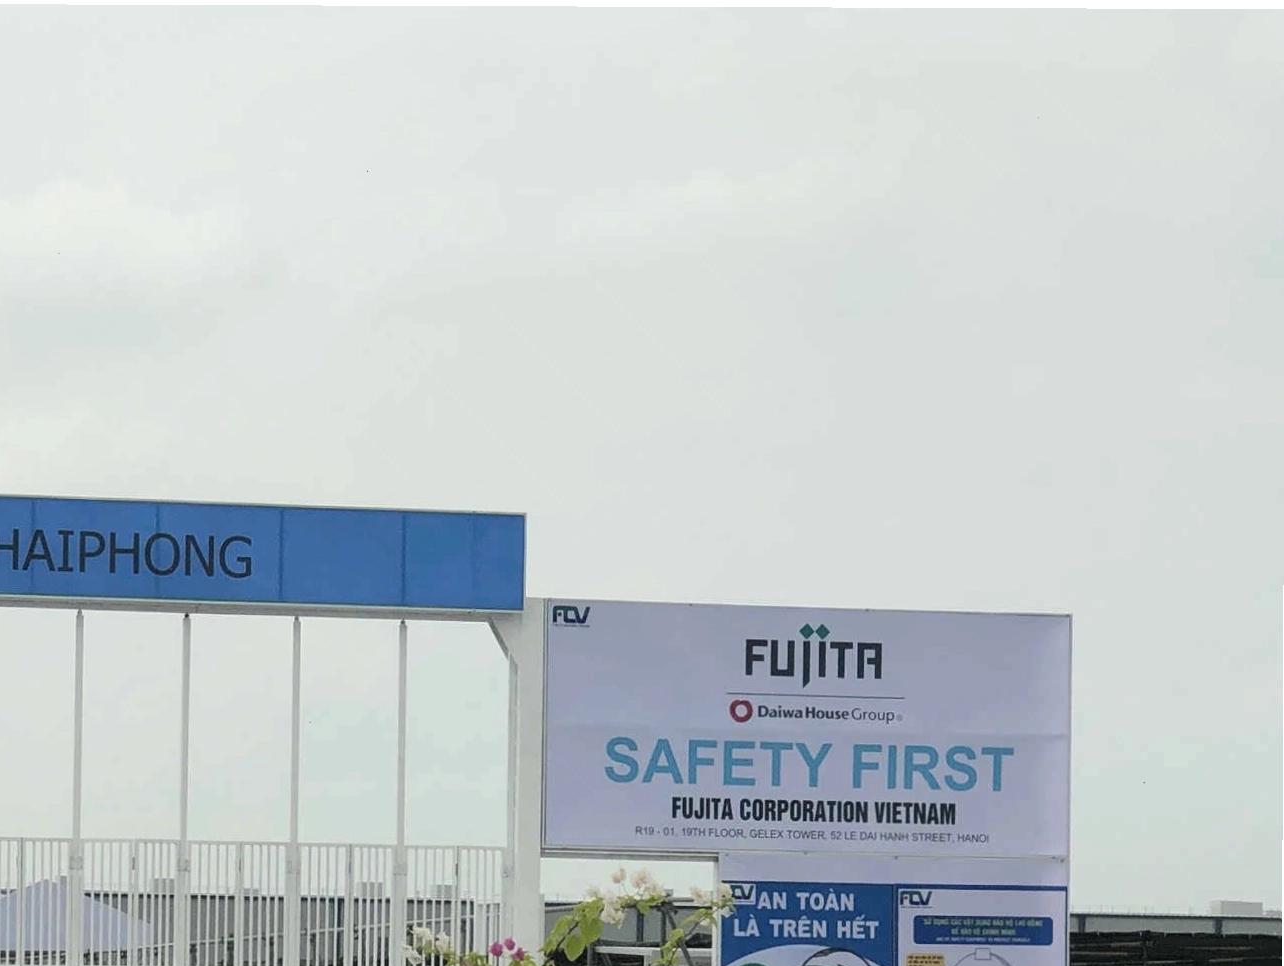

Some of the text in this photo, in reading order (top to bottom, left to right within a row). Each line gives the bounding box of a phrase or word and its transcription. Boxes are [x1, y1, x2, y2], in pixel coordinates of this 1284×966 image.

[745, 623, 883, 688] FUJITA
[758, 704, 803, 718] Daiwa
[806, 706, 849, 720] House
[604, 736, 1015, 792] SAFETY FIRST
[671, 796, 957, 826] FUJITA CORPORATION VIETNAM
[635, 826, 654, 836] R19
[682, 827, 706, 837] 19TH
[749, 829, 784, 839] GELEX
[830, 831, 842, 840] 52
[844, 831, 857, 840] LE
[860, 832, 877, 841] DAI
[880, 833, 908, 842] HANH
[958, 834, 988, 843] HANOI
[757, 888, 855, 911] AN TOÀN
[733, 914, 879, 939] LÀ TRÊN HẾT
